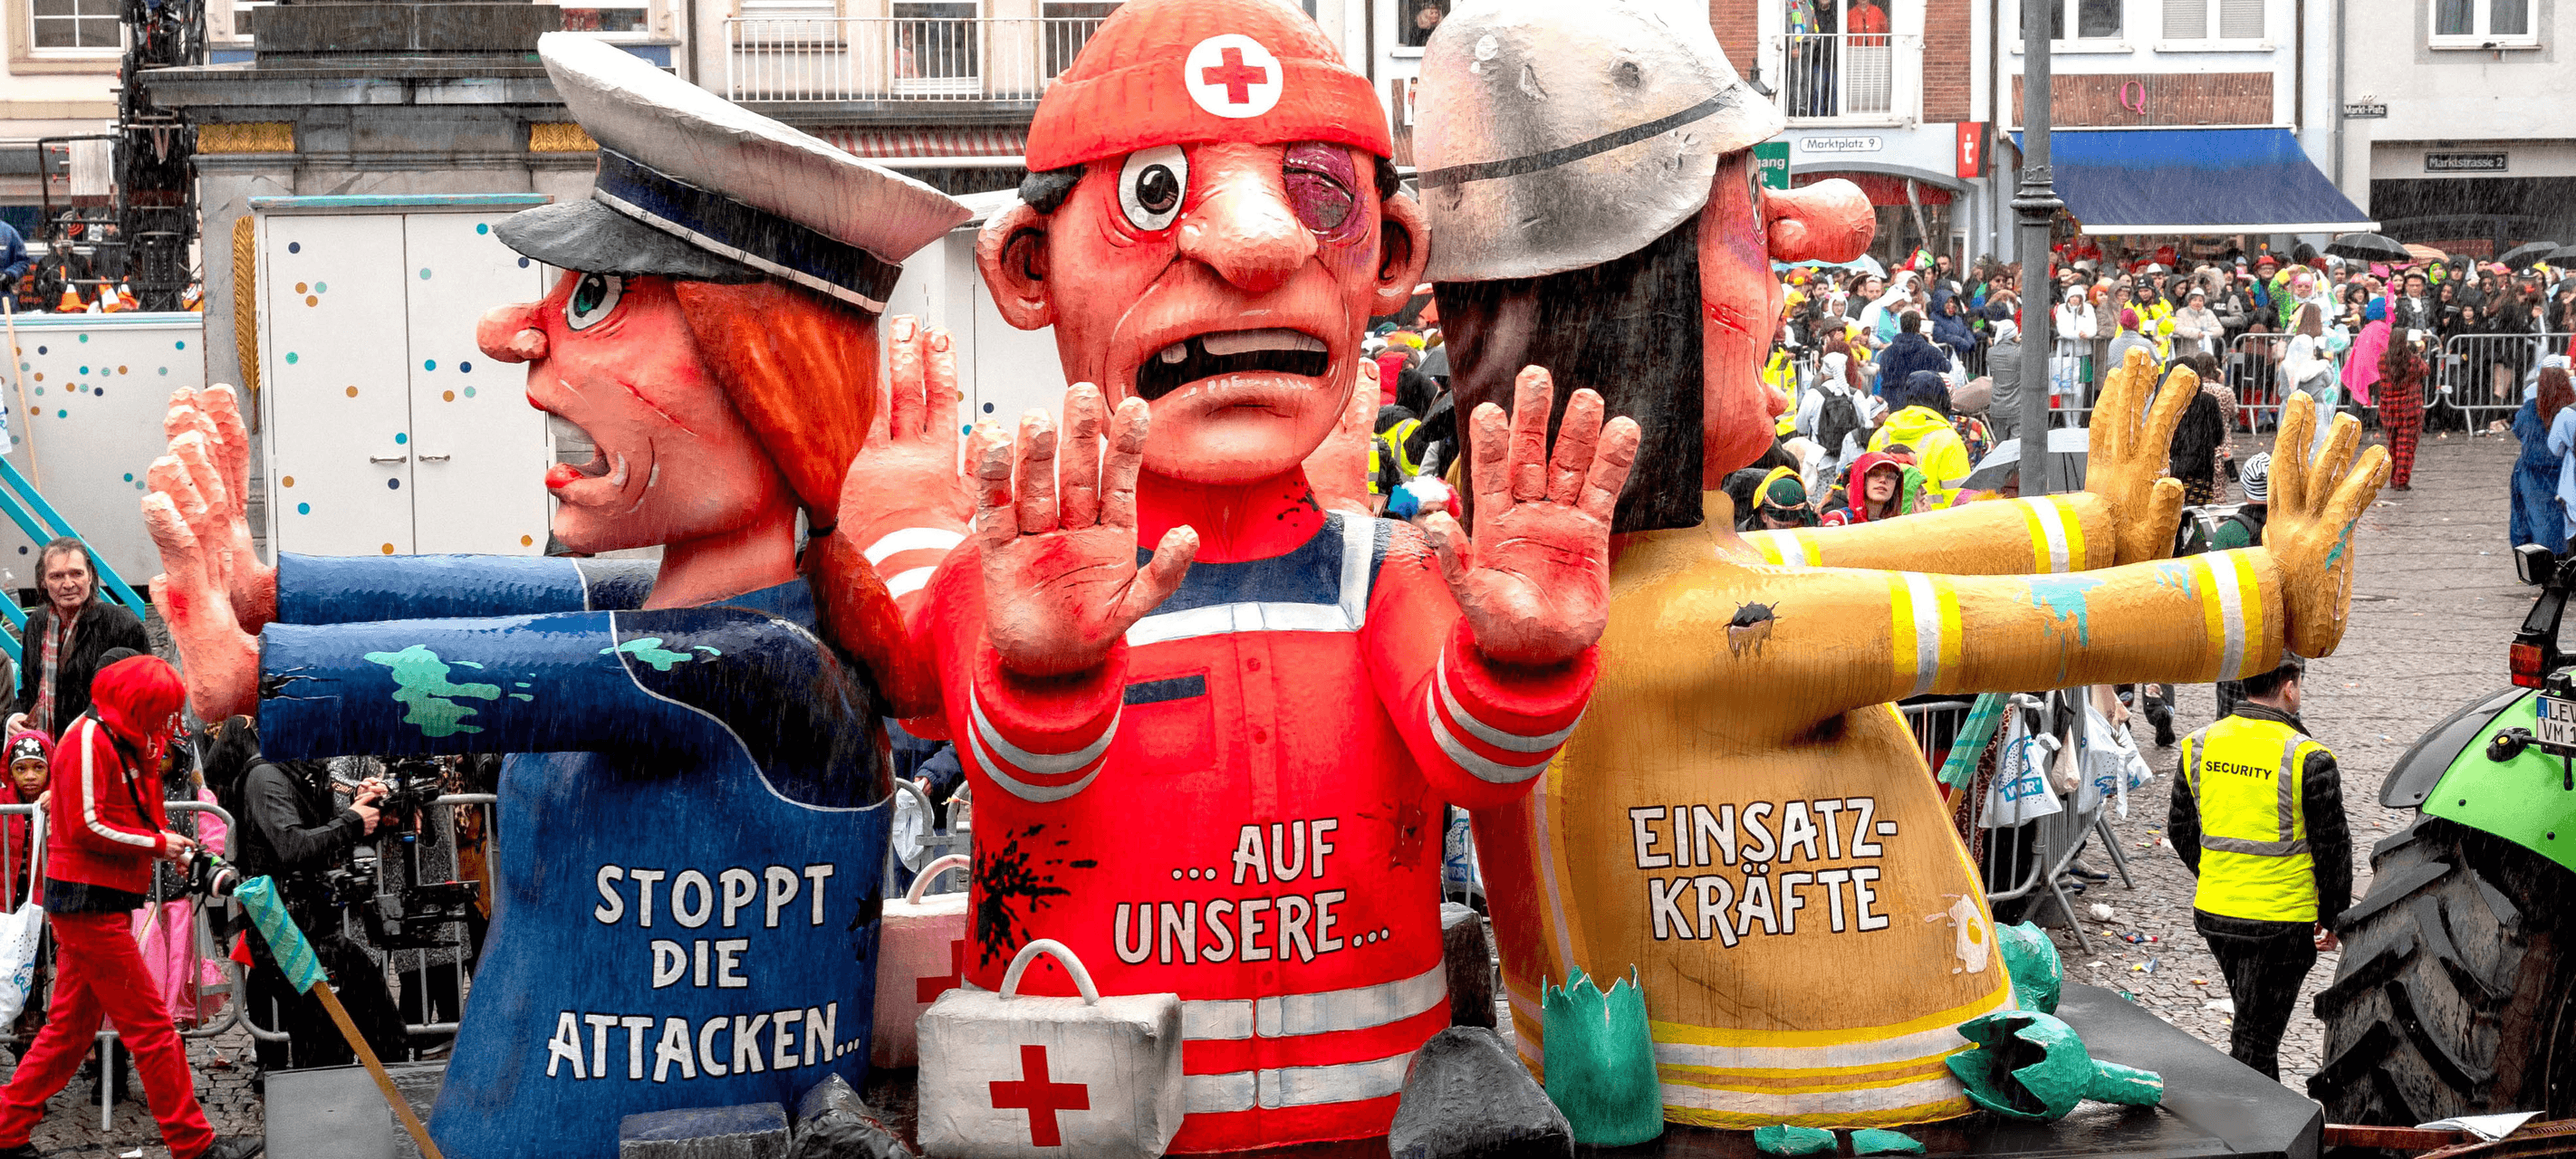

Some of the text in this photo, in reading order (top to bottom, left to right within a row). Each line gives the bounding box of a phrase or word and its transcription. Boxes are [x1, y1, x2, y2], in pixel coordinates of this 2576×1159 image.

[2120, 81, 2146, 115] Q
[1807, 138, 1875, 151] Marktplatz 9
[2428, 157, 2504, 168] Marktstrasse 2
[2542, 721, 2563, 742] VM
[2206, 761, 2272, 781] SECURITY
[1629, 796, 1898, 869] EINSATZ-
[593, 863, 835, 929] STOPPT
[1648, 861, 1889, 948] KRÄFTE
[650, 938, 750, 989] DIE
